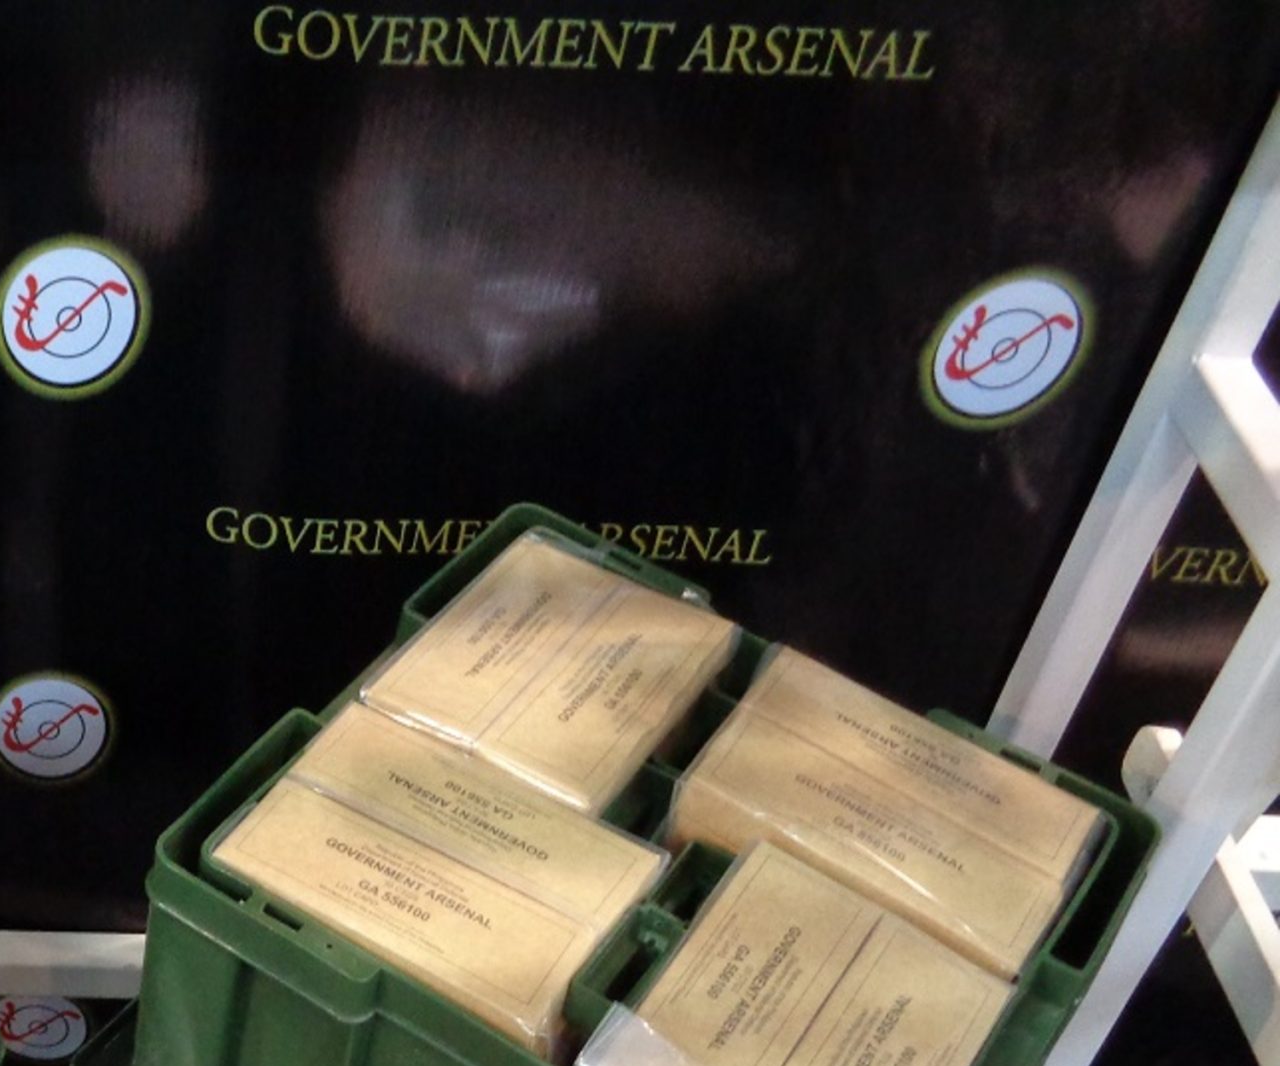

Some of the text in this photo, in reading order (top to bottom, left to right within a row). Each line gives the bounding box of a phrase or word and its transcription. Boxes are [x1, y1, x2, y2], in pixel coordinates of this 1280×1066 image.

[253, 4, 937, 81] GOVERNMENT ARSENAL
[205, 507, 771, 566] GOVERNME RSENAL
[388, 770, 450, 808] ARSENAL
[493, 805, 514, 821] GA
[451, 806, 550, 861] GOVERNMENT
[794, 773, 894, 832] GOVERNMENT
[898, 832, 964, 873] ARSENAL
[325, 837, 423, 891] GOVERNMENT
[425, 889, 492, 930] ARSENAL
[358, 880, 380, 896] GA
[384, 891, 431, 922] 556100
[733, 944, 751, 962] GA
[748, 926, 802, 1002] GOVERNMENT
[707, 998, 750, 1050] ARSENAL
[873, 997, 912, 1045] ARSENAL
